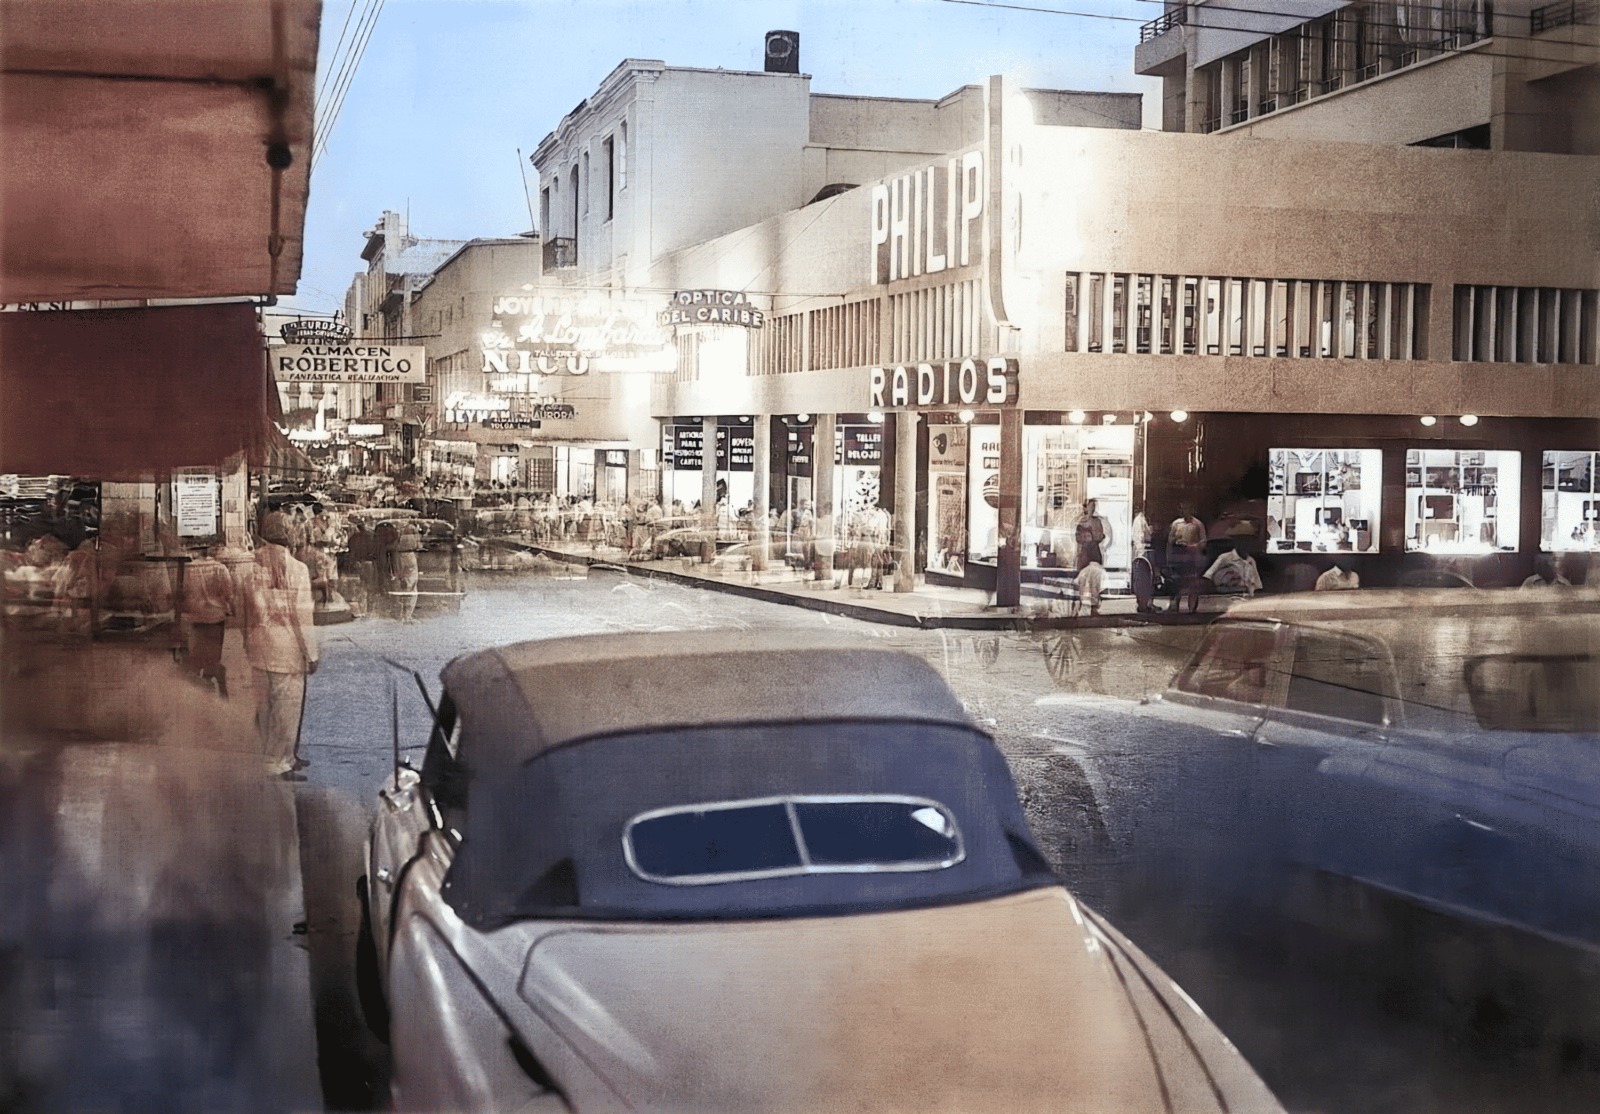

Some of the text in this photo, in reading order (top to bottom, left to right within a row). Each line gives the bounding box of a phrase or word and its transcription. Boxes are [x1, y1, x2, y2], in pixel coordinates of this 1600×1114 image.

[871, 150, 983, 285] PHILIP
[678, 290, 745, 306] OPTICA
[660, 307, 763, 327] DEL CARIBE
[301, 346, 391, 357] ALMACEN
[279, 357, 411, 373] ROBERTICO
[289, 373, 342, 381] FANTASTICA
[870, 357, 1010, 407] RADIOS
